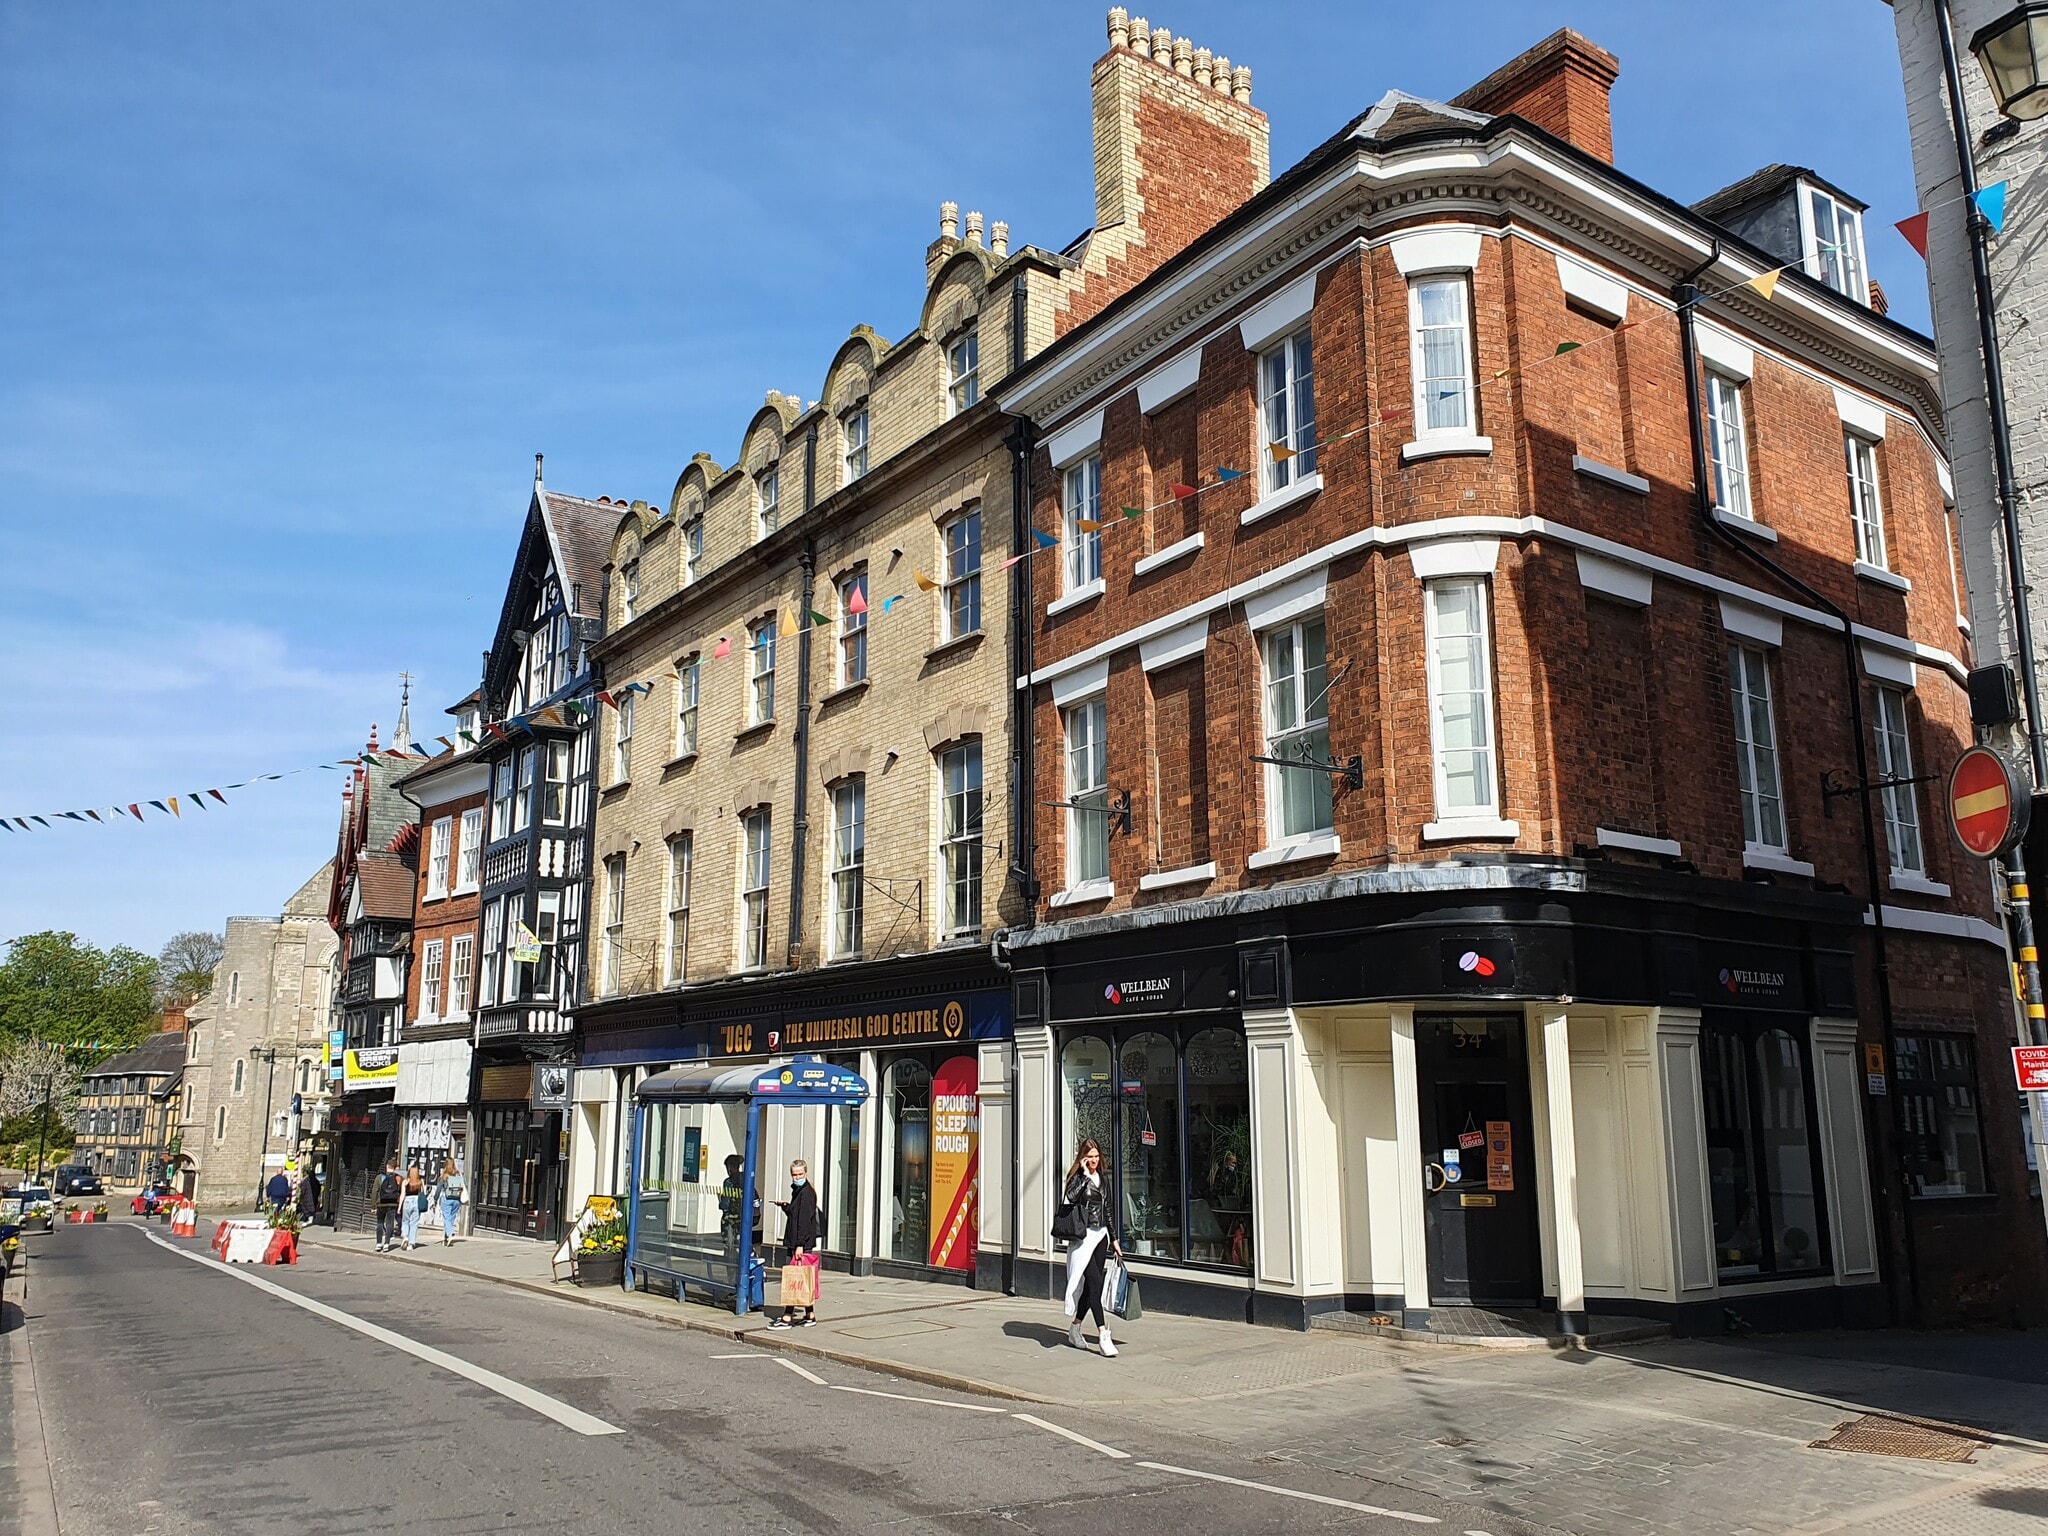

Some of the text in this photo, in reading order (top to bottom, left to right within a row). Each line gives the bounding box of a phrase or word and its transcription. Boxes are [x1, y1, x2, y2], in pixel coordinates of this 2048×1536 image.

[1120, 977, 1170, 994] WELLBEAN
[1733, 970, 1784, 986] WELLBEAN
[785, 1009, 939, 1044] THE UNIVERSAL GOD CENTRE
[726, 1024, 753, 1053] UGC
[1455, 1032, 1482, 1048] 34
[359, 1049, 398, 1057] COOPER
[782, 1074, 792, 1082] D1
[935, 1095, 977, 1112] ENOUGH
[935, 1135, 969, 1153] ROUGH
[1462, 1138, 1482, 1149] CLOSED
